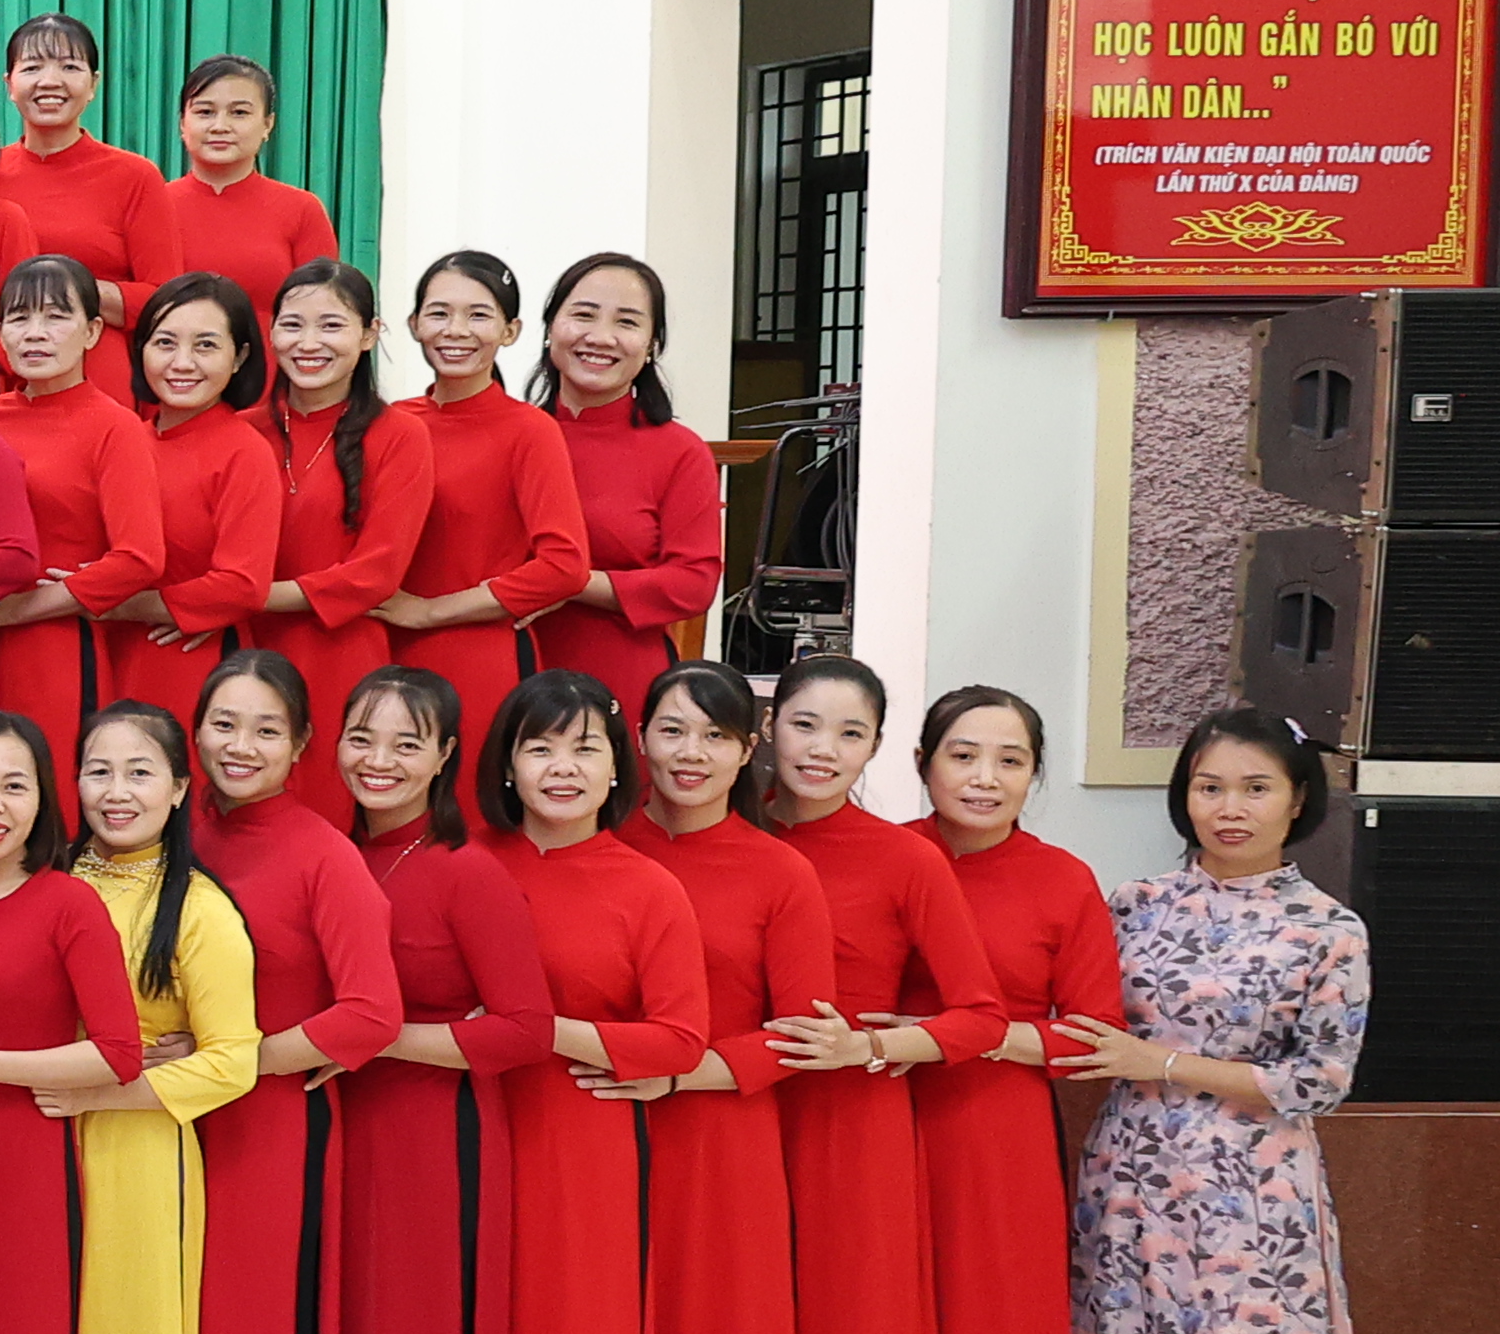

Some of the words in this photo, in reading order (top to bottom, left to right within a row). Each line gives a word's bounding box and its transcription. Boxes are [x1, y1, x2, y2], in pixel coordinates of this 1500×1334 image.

[1093, 21, 1152, 64] HỌC
[1168, 15, 1244, 57] LUÔN
[1260, 9, 1320, 57] GẮN
[1336, 15, 1374, 57] BÓ
[1391, 15, 1438, 56] VỚI
[1091, 77, 1172, 119] NHÂN
[1095, 142, 1158, 165] (TRÍCH
[1162, 142, 1201, 164] VĂN
[1203, 142, 1250, 168] KIỆN
[1252, 145, 1286, 167] ĐẠI
[1288, 142, 1323, 167] HỘI
[1326, 142, 1377, 163] TOÀN
[1379, 139, 1431, 165] QUỐC
[1198, 171, 1238, 193] THỨ
[1240, 173, 1253, 193] X
[1256, 169, 1295, 193] CỦA
[1298, 169, 1359, 194] ĐẢNG)
